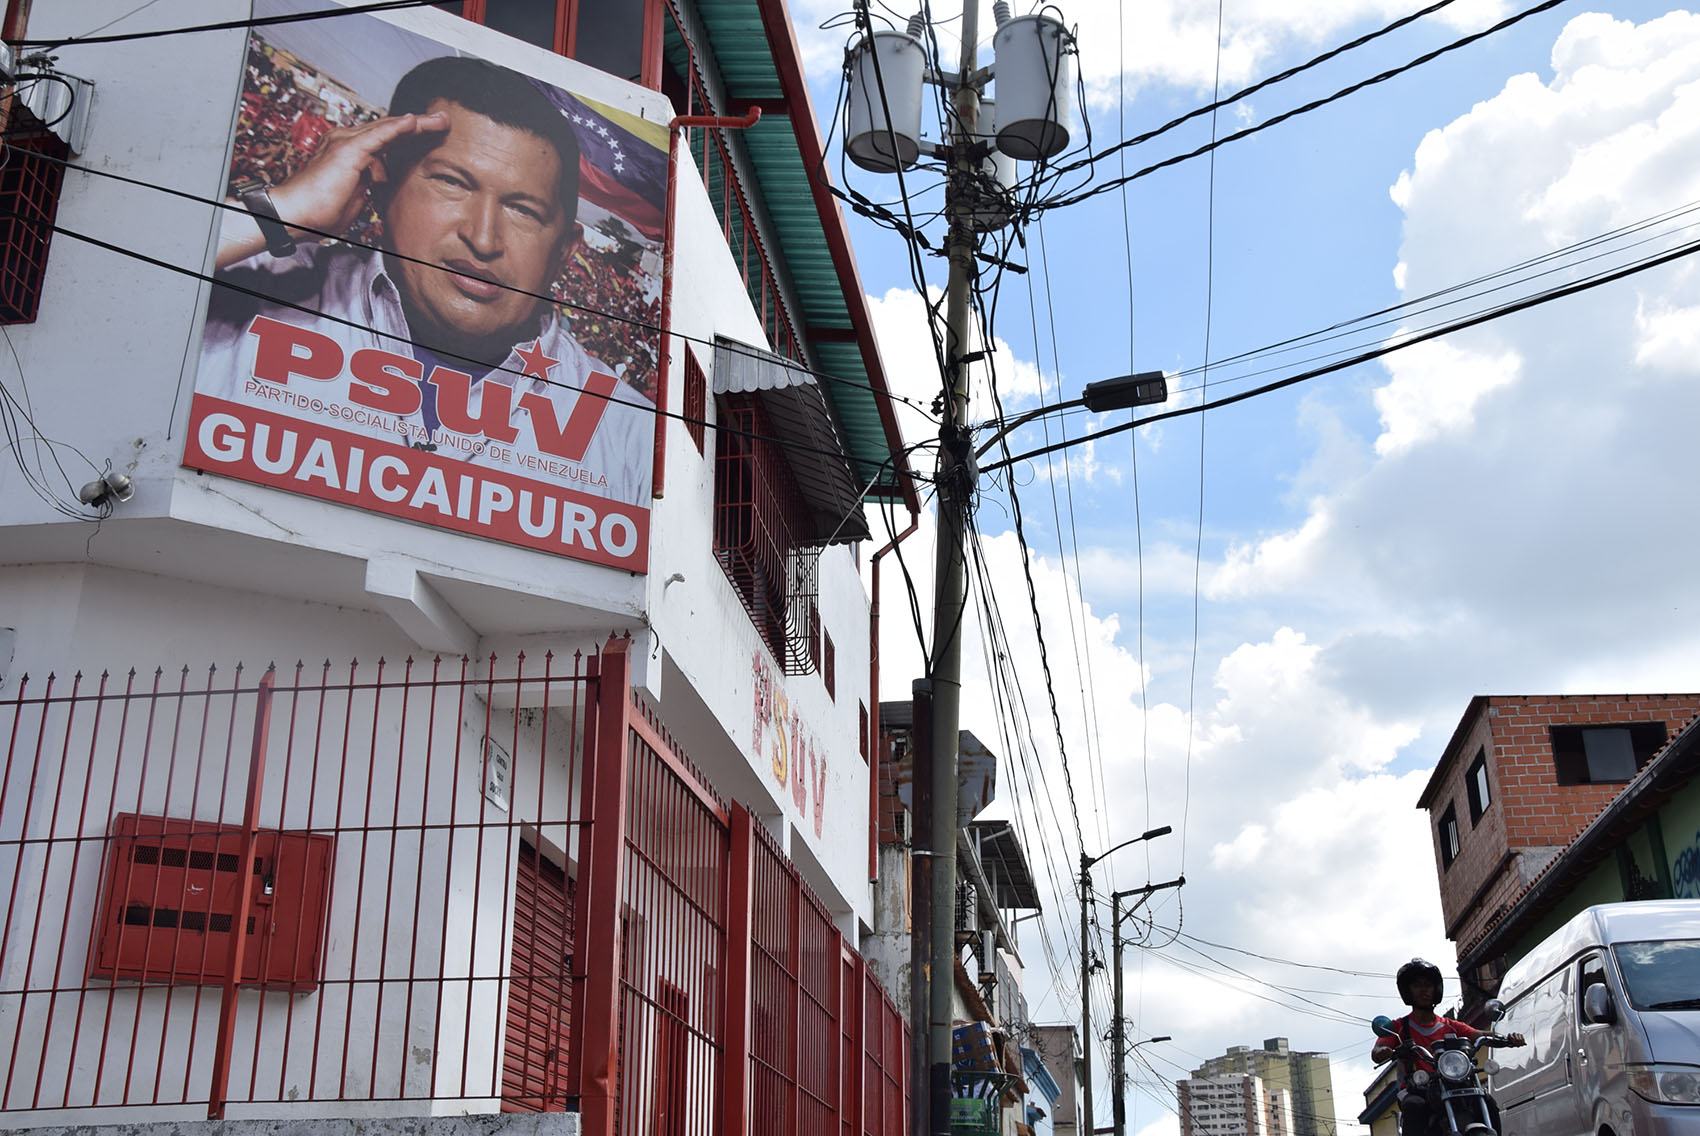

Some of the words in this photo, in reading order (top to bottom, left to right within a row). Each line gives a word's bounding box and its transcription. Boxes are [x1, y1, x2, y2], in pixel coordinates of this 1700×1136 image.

[197, 413, 639, 558] GUAICAIPURO
[245, 381, 324, 413] PARTIDO
[329, 403, 429, 441] SOCIALISTA
[433, 430, 485, 455] UNIDO
[490, 446, 513, 462] DE
[516, 453, 608, 488] VENEZUELA
